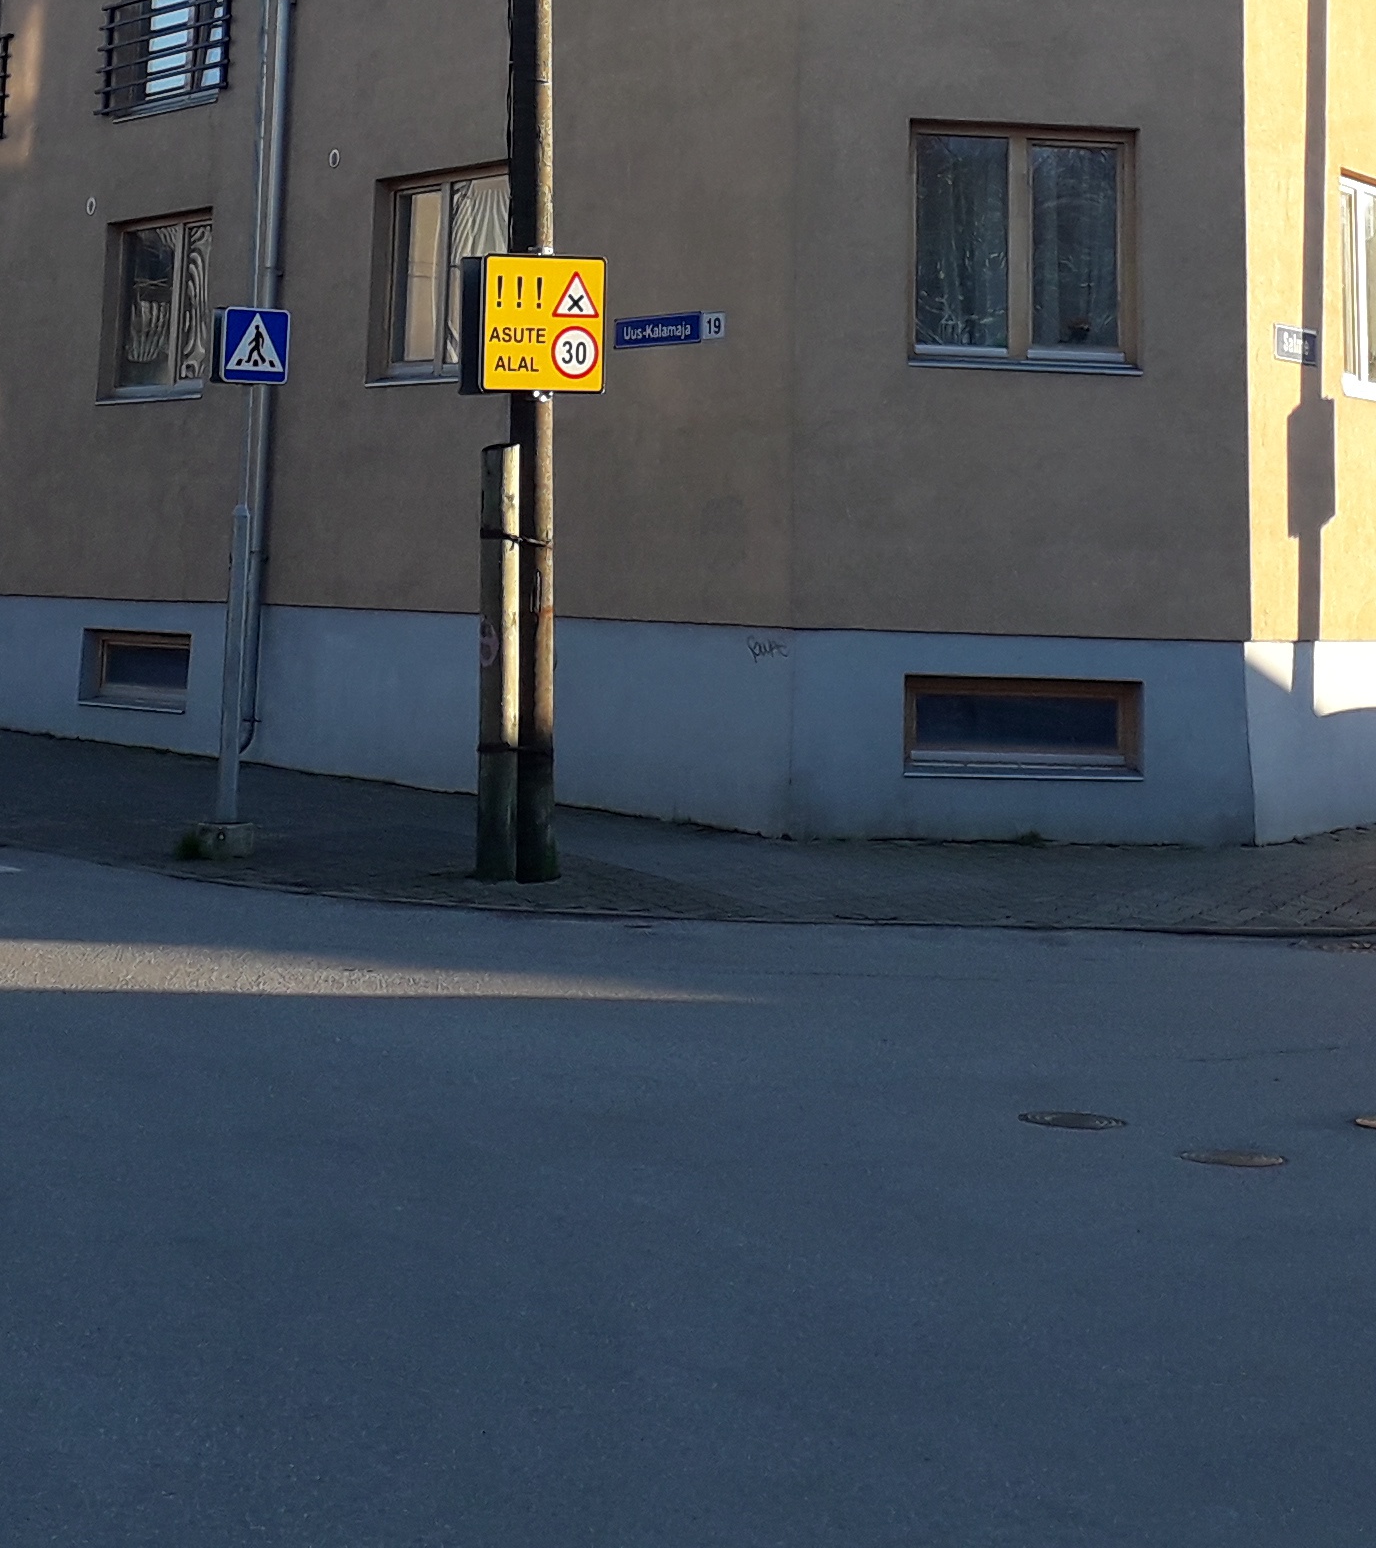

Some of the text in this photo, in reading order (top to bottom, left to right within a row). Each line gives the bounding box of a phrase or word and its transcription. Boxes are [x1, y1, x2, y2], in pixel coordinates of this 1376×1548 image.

[489, 326, 546, 344] ASUTE
[623, 321, 691, 340] Uus-Kalamaja
[706, 317, 722, 335] 19
[561, 340, 587, 365] 30
[494, 356, 540, 372] ALAL
